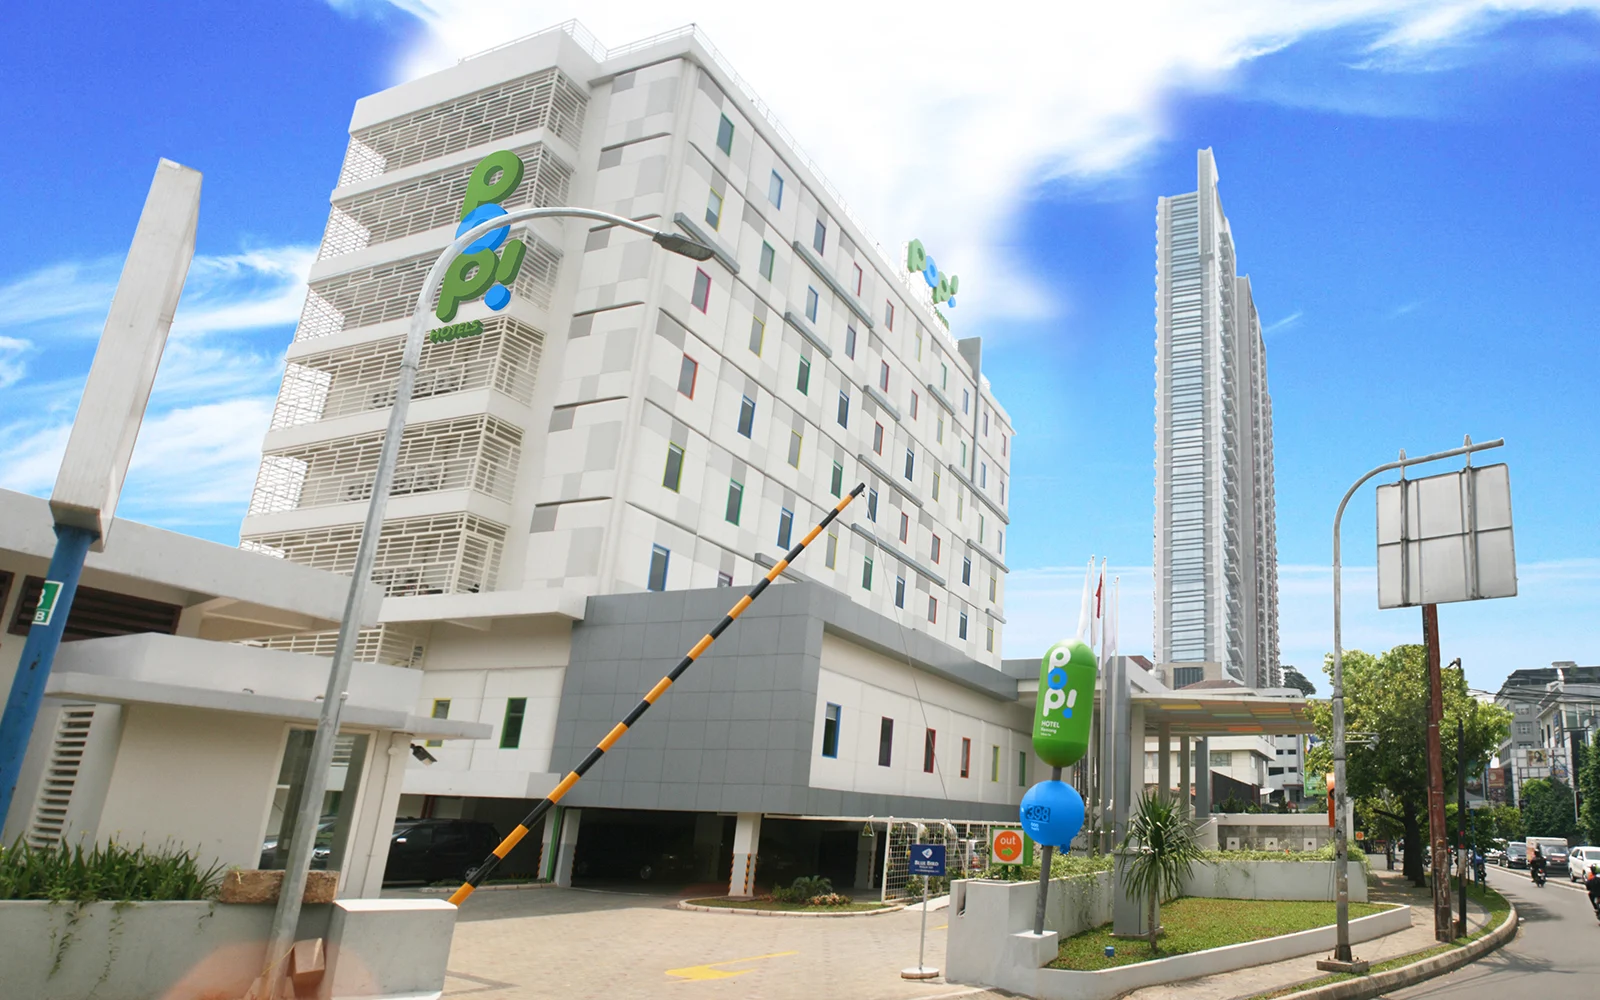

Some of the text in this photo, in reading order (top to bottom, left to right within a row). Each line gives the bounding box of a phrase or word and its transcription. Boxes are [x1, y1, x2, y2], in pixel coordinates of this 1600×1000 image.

[430, 320, 483, 343] HOTELS
[1041, 720, 1060, 728] HOTEL
[1026, 805, 1049, 821] 398
[1000, 836, 1016, 845] out
